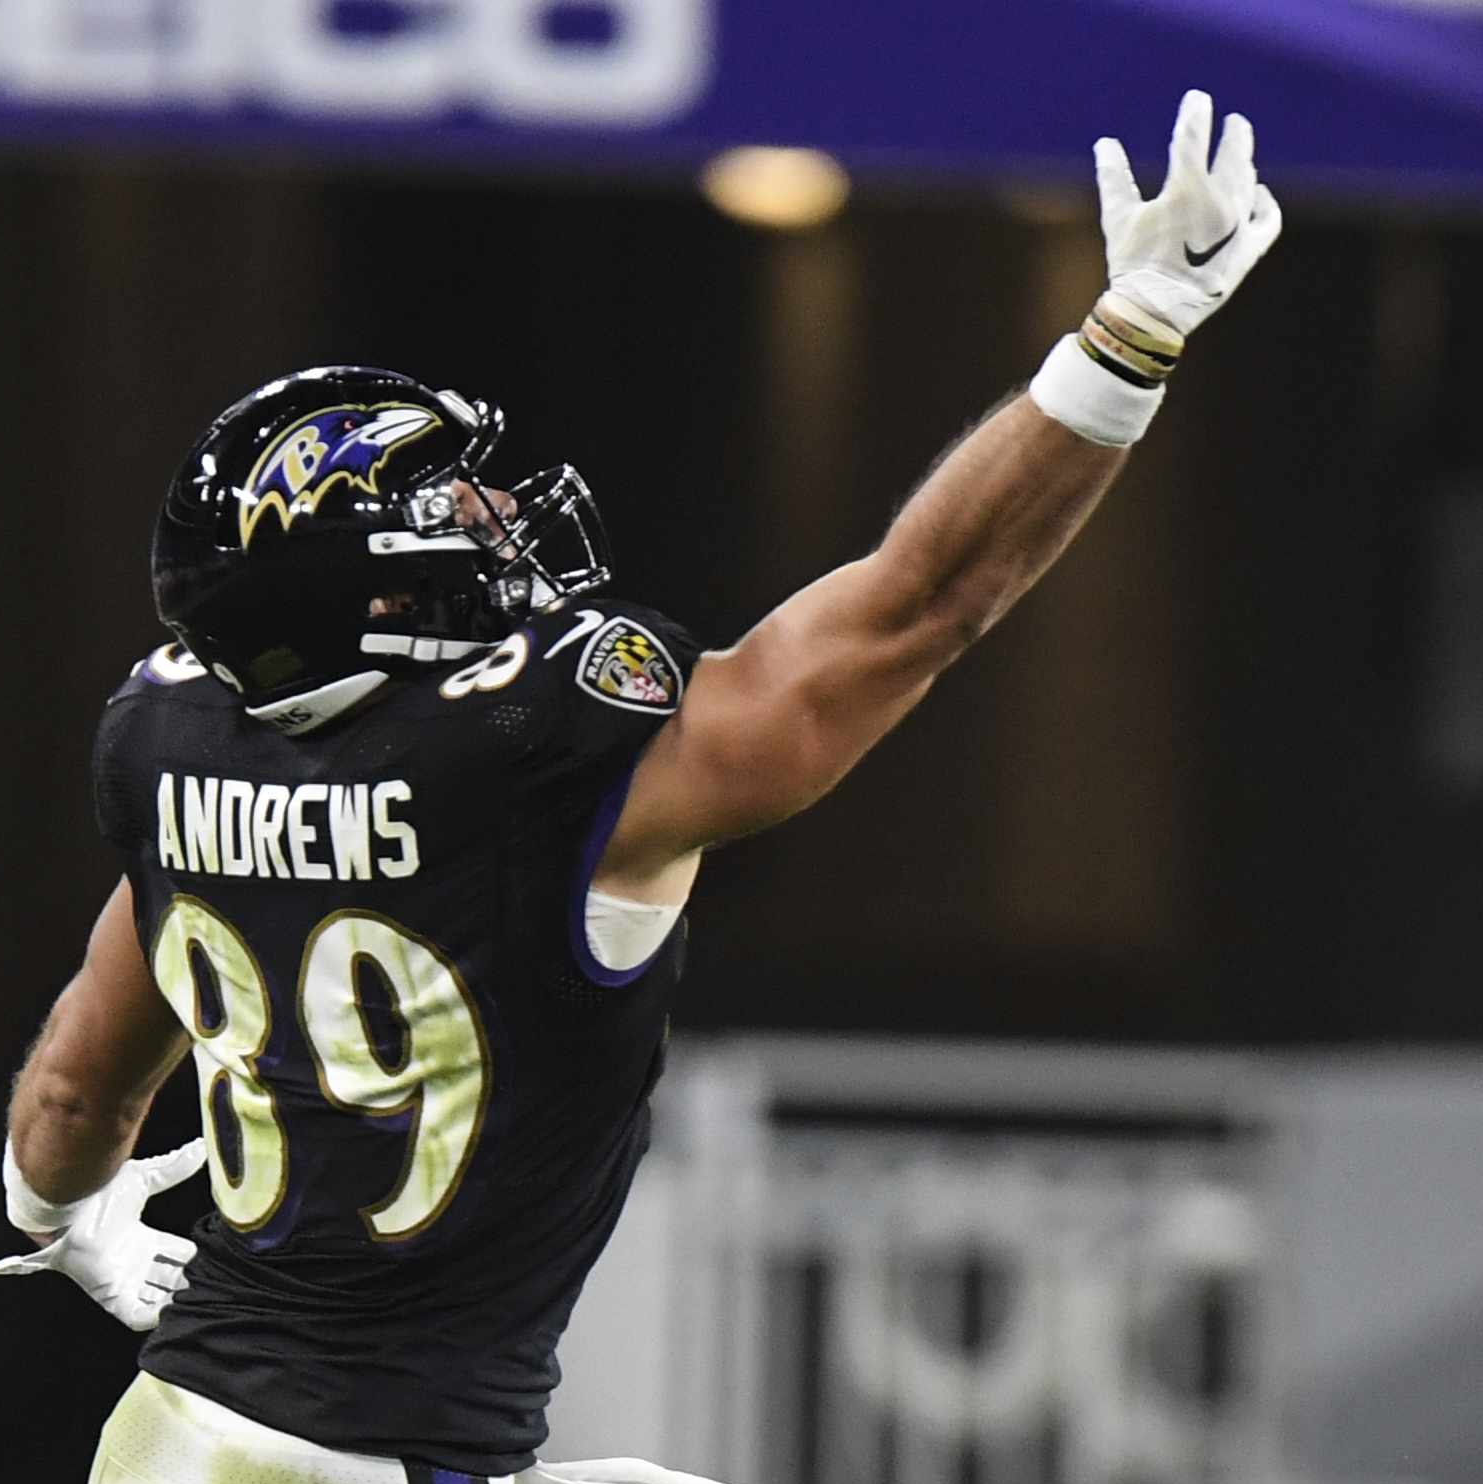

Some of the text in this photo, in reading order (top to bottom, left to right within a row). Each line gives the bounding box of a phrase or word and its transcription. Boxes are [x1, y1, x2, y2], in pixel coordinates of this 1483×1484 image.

[438, 632, 534, 700] 8
[586, 625, 628, 680] RAVENS
[157, 771, 421, 881] ANDREWS
[152, 892, 492, 1243] 89
